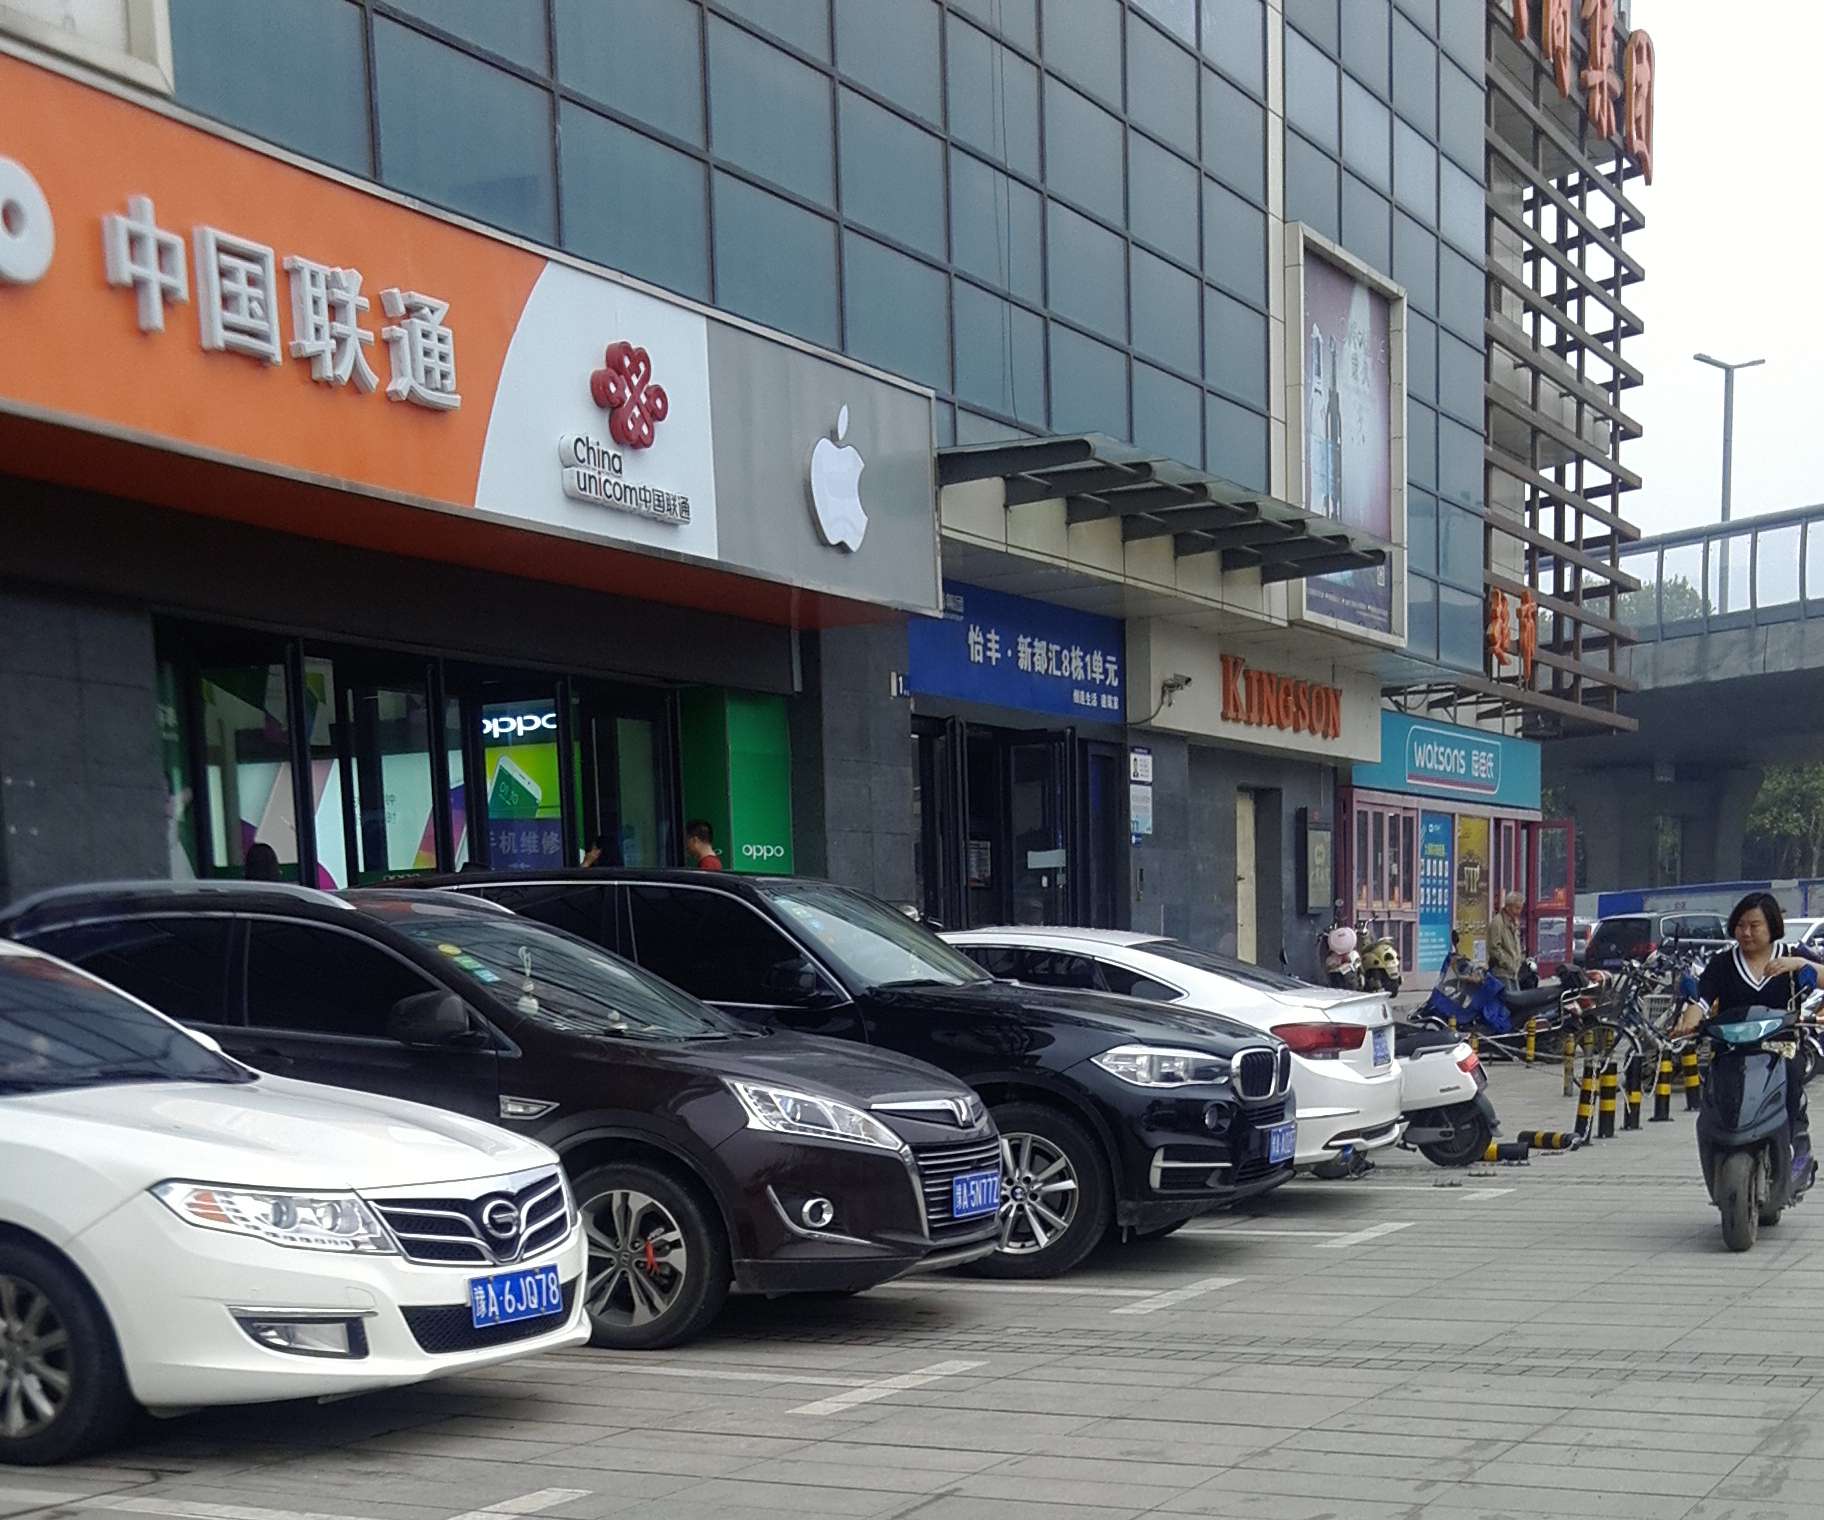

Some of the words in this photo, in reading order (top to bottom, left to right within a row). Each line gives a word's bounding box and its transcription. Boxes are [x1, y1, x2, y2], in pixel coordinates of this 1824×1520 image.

[101, 195, 462, 411] 中国联通
[573, 436, 623, 475] China
[1219, 653, 1343, 741] KINGSON
[1413, 740, 1466, 775] watsons
[742, 843, 785, 861] oppo
